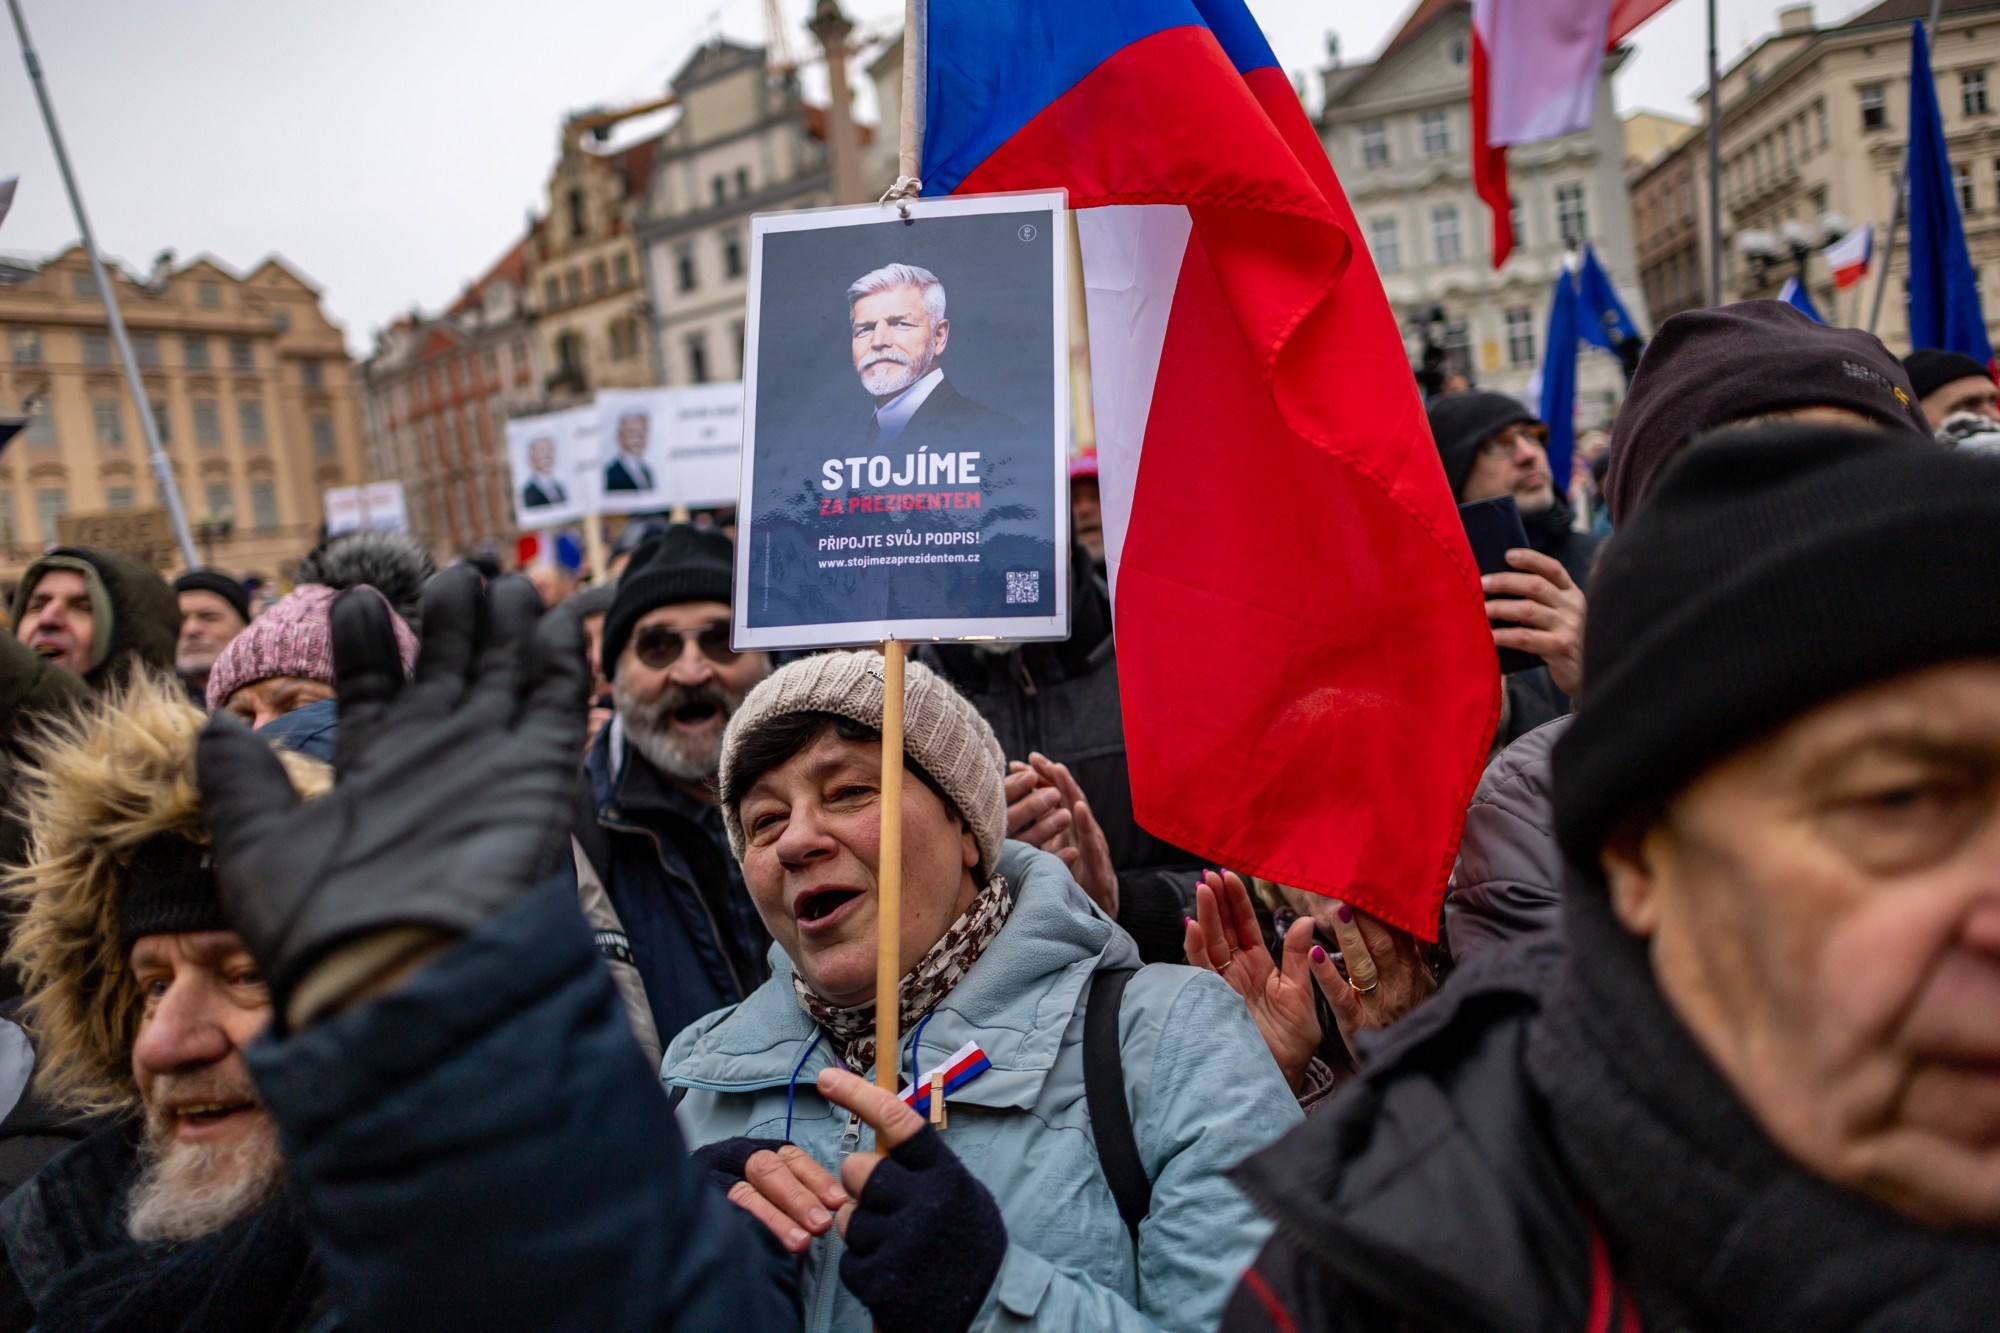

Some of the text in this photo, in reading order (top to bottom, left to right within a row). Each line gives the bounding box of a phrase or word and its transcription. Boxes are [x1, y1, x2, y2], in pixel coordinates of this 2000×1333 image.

[822, 445, 981, 491] STOJÍME
[820, 491, 981, 516] ZA PREZIDENTEM
[818, 529, 980, 551] PŘIPOJTE SVŮJ PODPIS!
[818, 553, 980, 569] www.stojimezaprezidentem.cz
